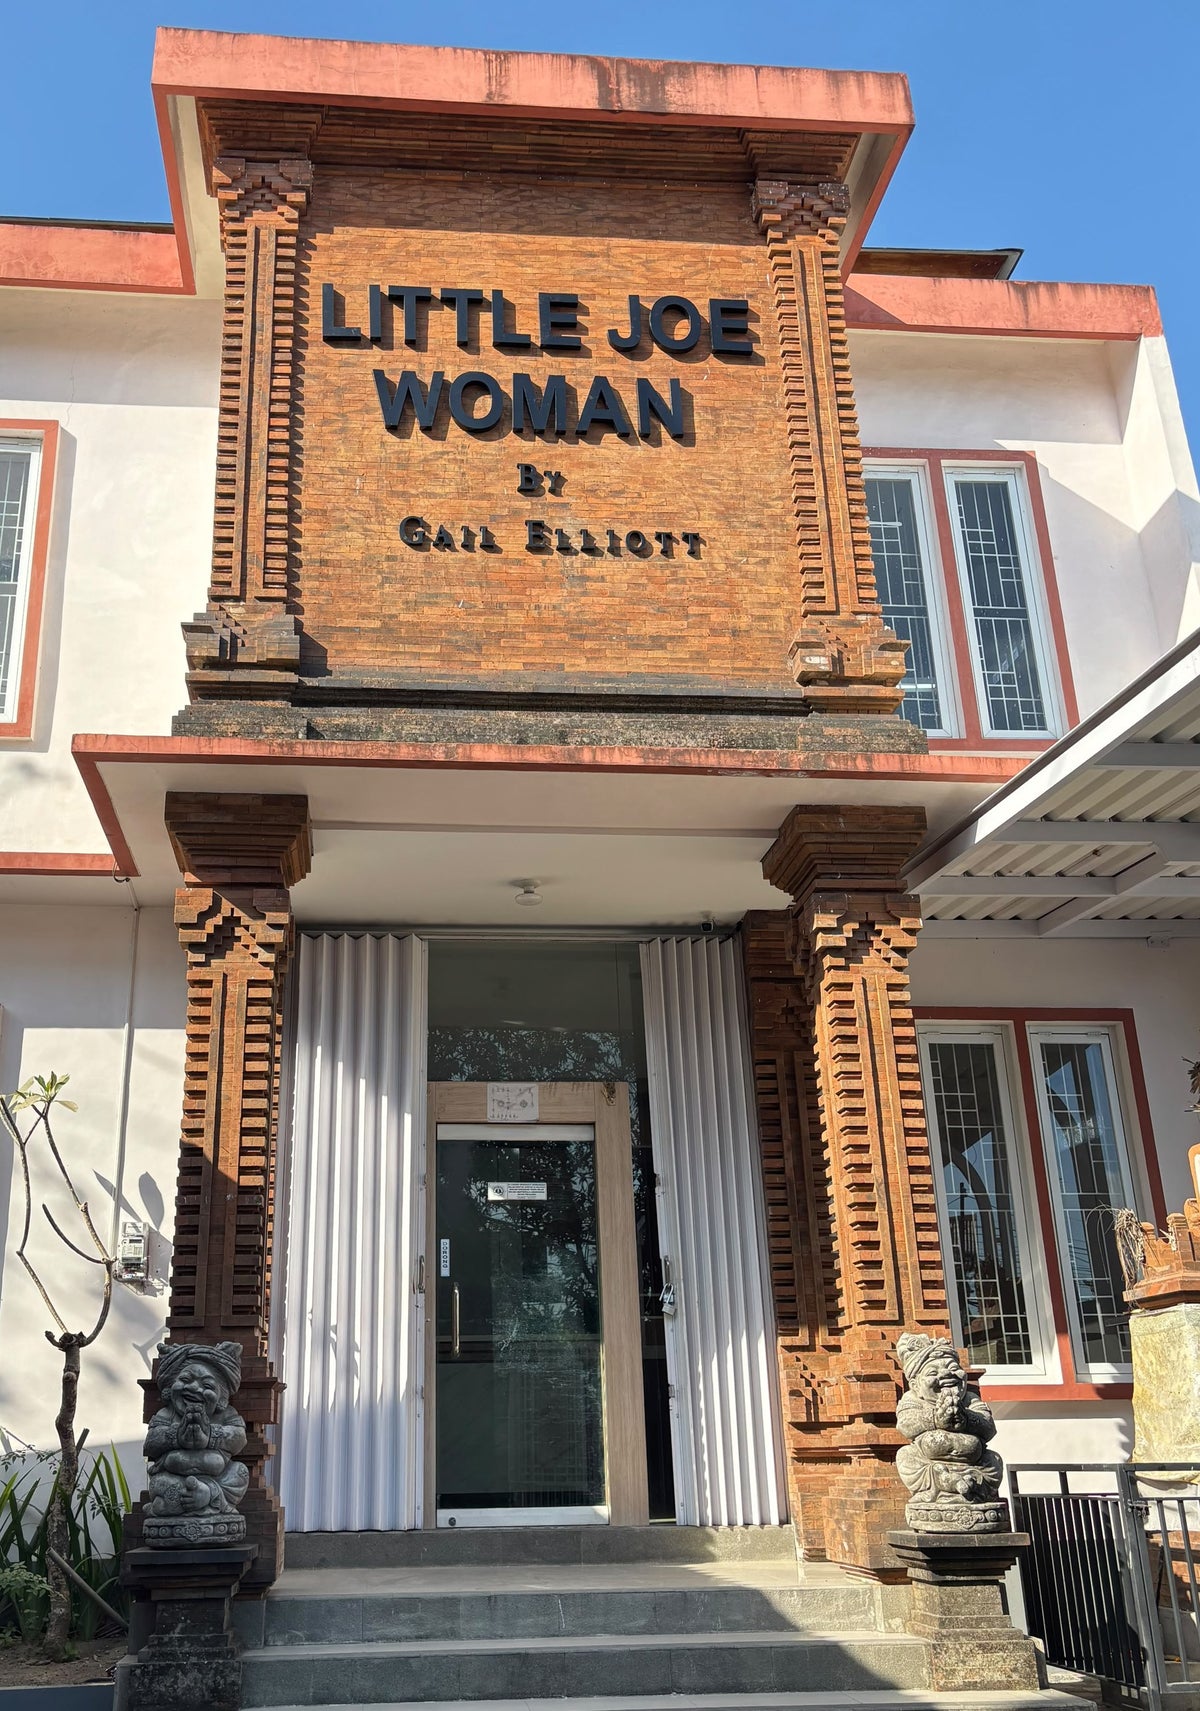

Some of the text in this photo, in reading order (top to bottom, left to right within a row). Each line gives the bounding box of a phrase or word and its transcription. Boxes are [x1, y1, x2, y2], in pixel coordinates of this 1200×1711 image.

[323, 283, 754, 355] LITTLE JOE
[373, 369, 684, 438] WOMAN
[399, 516, 700, 555] GAIL ELLIOTT
